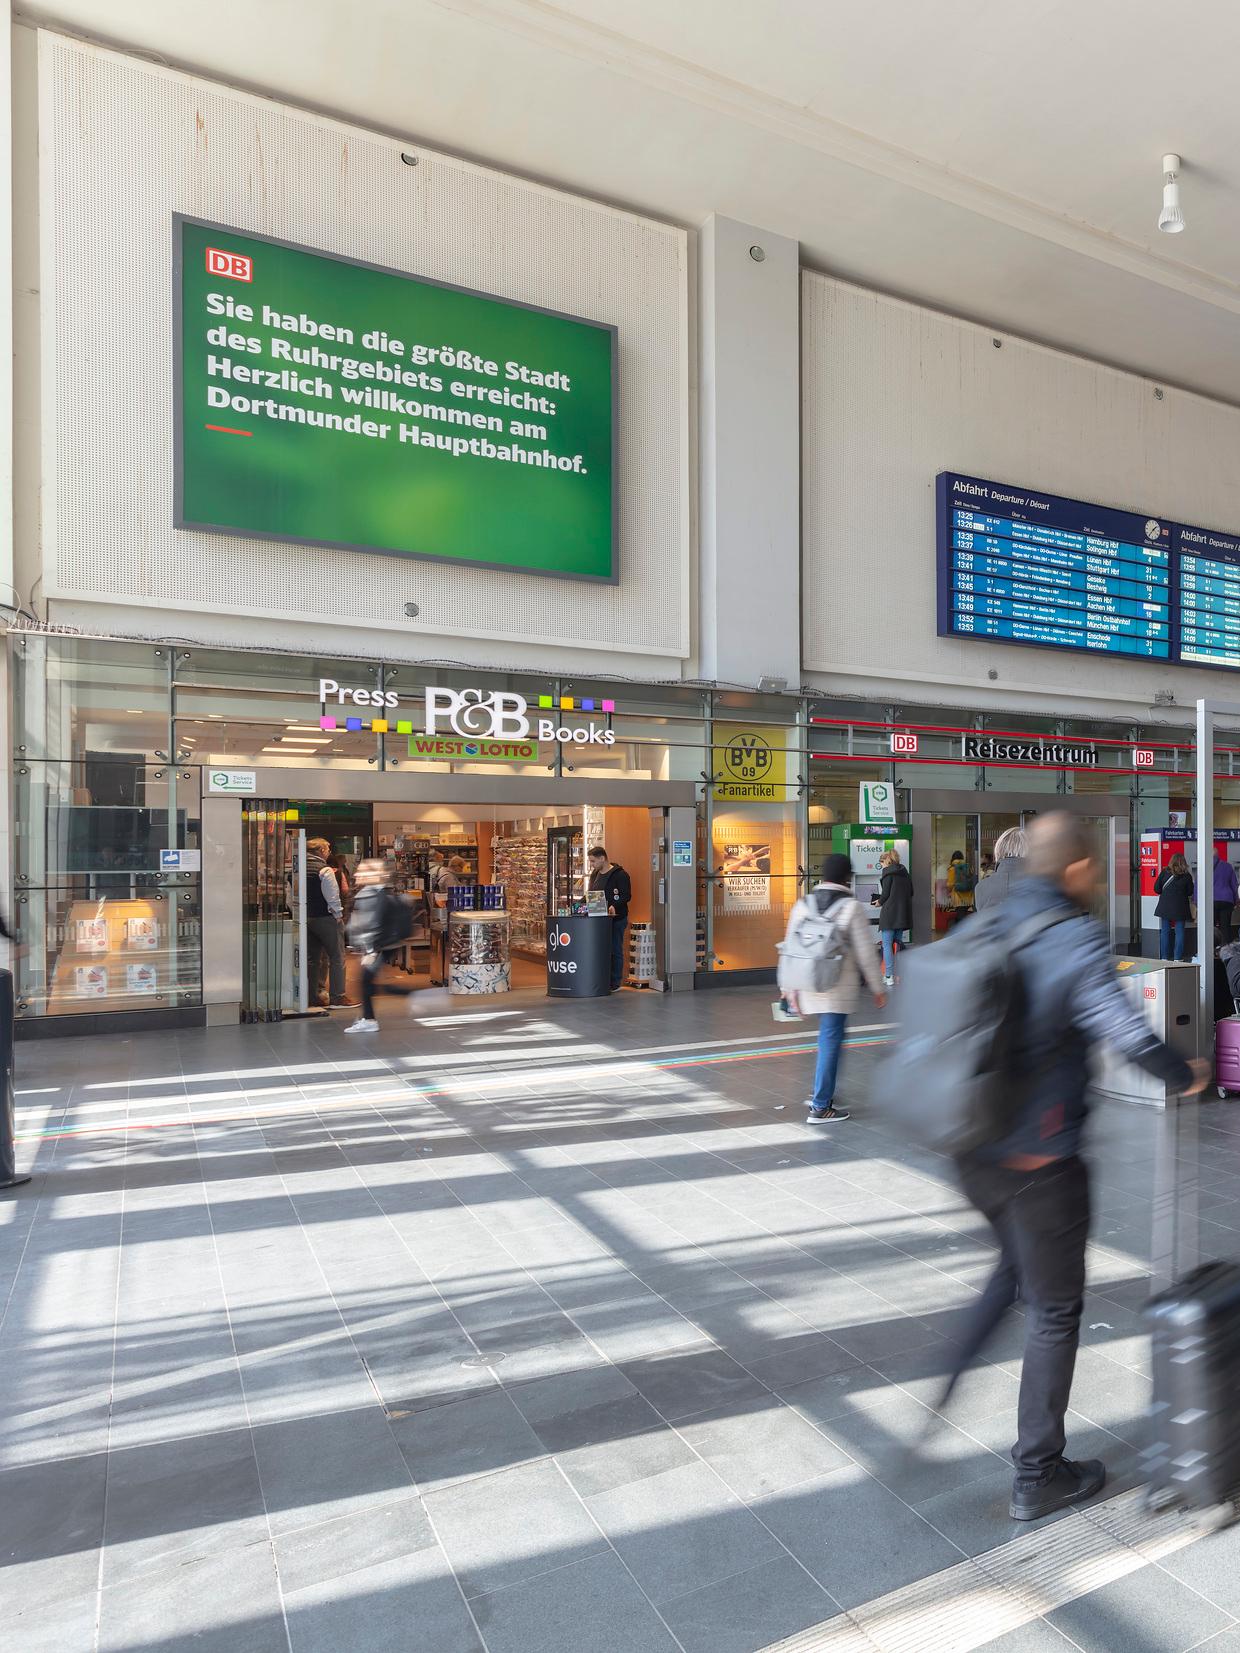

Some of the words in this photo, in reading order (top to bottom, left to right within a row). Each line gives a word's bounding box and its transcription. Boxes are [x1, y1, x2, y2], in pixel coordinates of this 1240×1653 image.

[210, 250, 250, 280] DB
[207, 294, 253, 322] Sie
[262, 305, 354, 346] haben
[362, 331, 404, 356] die
[412, 343, 498, 376] größte
[506, 361, 570, 392] Stadt
[207, 326, 262, 354] des
[272, 338, 442, 392] Ruhrgebiets
[451, 381, 556, 416] erreicht:
[208, 355, 332, 398] Herzlich
[342, 384, 502, 432] willkommen
[510, 420, 546, 440] am
[208, 386, 390, 438] Dortmunder
[400, 424, 588, 474] Hauptbahnhof.
[953, 481, 988, 497] Abfahrt
[991, 491, 1024, 505] Departure
[957, 511, 973, 520] 13:25
[957, 520, 973, 528] 13:26
[957, 532, 973, 540] 13:35
[1181, 530, 1207, 544] Abfahrt
[1209, 538, 1234, 550] Departure
[957, 540, 973, 548] 13:37
[1087, 537, 1109, 548] Hamburg
[1087, 545, 1108, 557] Solingen
[958, 553, 973, 561] 13:39
[1087, 556, 1101, 564] Lünen
[958, 561, 973, 569] 13:41
[1087, 564, 1110, 575] Stuttgart
[1087, 575, 1105, 584] Geseke
[958, 582, 973, 590] 13:45
[1087, 583, 1107, 593] Bestwig
[1087, 595, 1102, 603] Essen
[958, 602, 973, 610] 13:49
[1087, 603, 1105, 611] Aachen
[958, 615, 974, 623] 13:52
[1087, 613, 1102, 621] Berlin
[1103, 615, 1130, 625] Ostbahnhof
[958, 623, 974, 631] 13:53
[1087, 621, 1109, 630] München
[1087, 633, 1111, 642] Enschede
[1087, 640, 1107, 649] Iserlohn
[319, 679, 399, 708] Press
[425, 687, 530, 740] P&B
[538, 720, 616, 745] Books
[416, 740, 463, 754] WEST
[480, 742, 532, 757] LOTTO
[731, 738, 768, 768] BVB
[895, 736, 916, 751] DB
[962, 737, 1099, 764] Reisezentrum
[1138, 752, 1153, 765] DB
[742, 766, 756, 777] 09
[723, 784, 775, 798] Fanartikel
[549, 924, 571, 951] glo
[547, 960, 577, 974] vuse
[1144, 988, 1156, 999] DB
